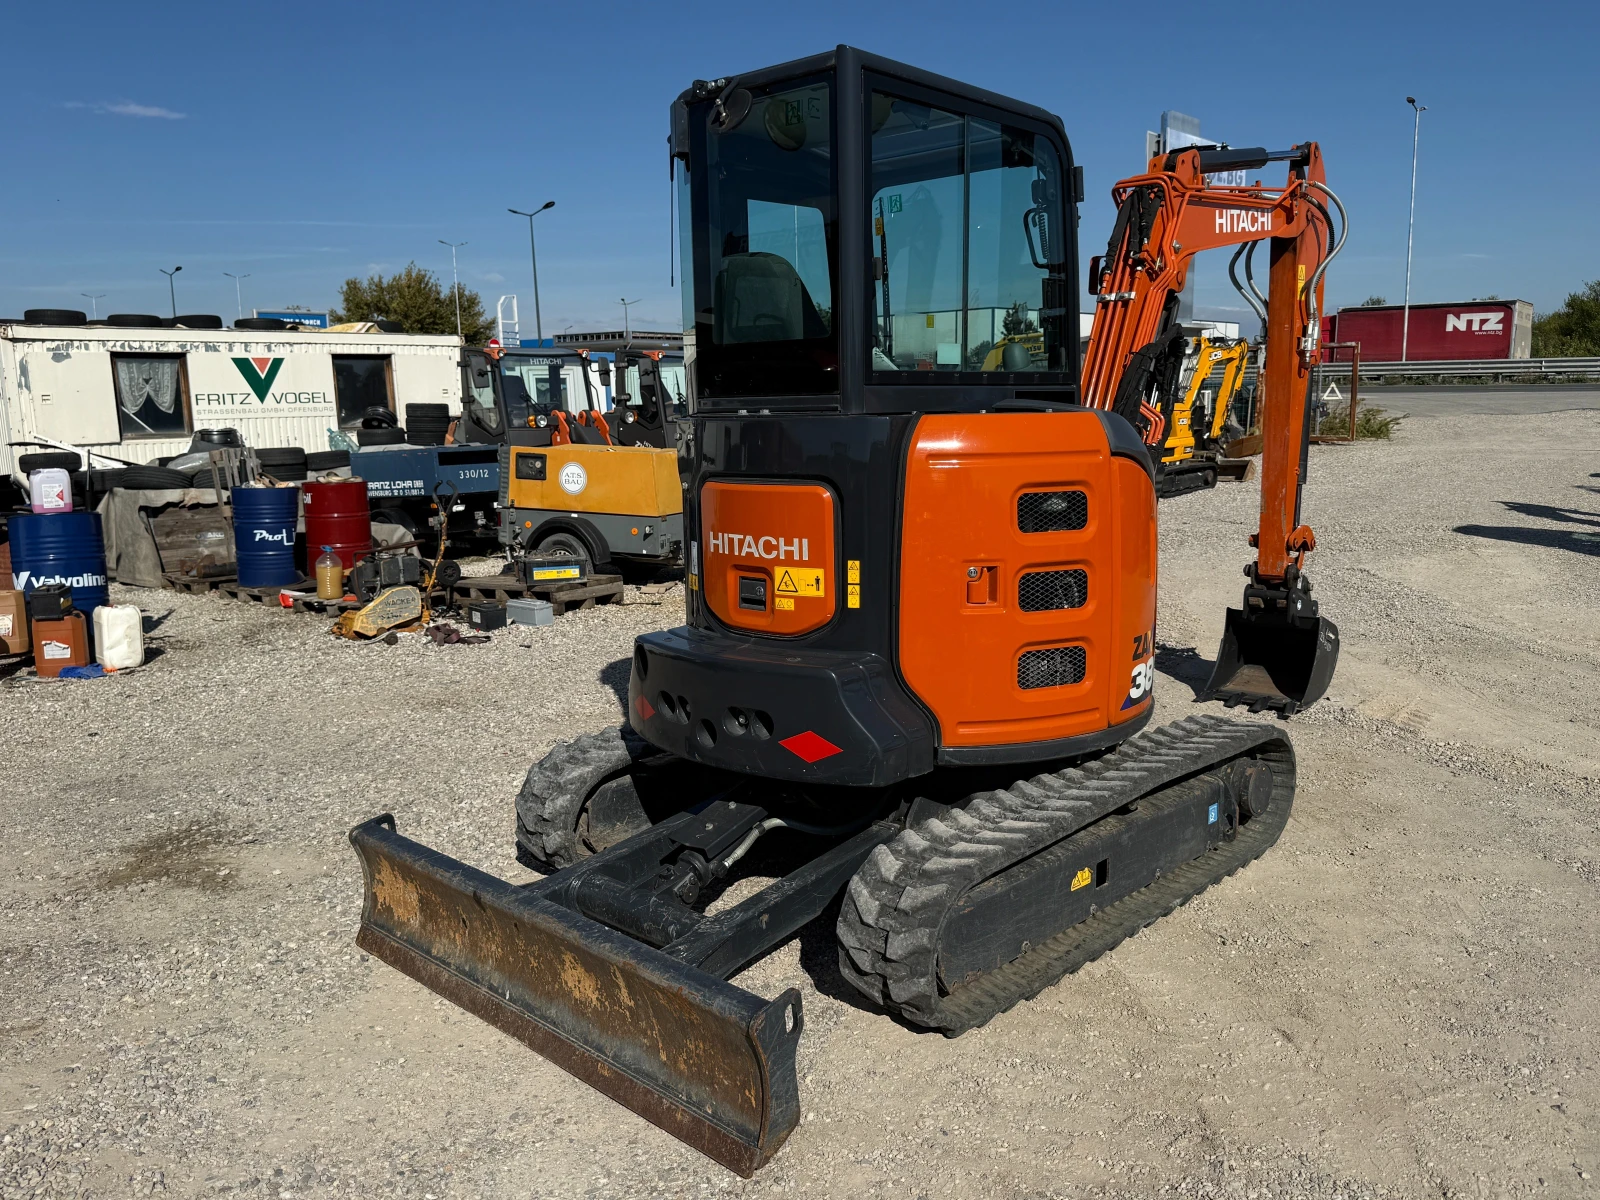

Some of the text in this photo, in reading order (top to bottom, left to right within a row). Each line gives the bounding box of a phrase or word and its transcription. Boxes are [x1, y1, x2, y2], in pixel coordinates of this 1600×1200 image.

[1215, 208, 1272, 234] HITACHI
[1445, 312, 1504, 332] NTZ
[1209, 350, 1222, 361] JCB
[195, 392, 333, 406] FRITZ VOGEL
[196, 408, 258, 416] STRASSENBAU
[287, 406, 334, 414] OFFENBURG
[459, 469, 489, 480] 330/12
[391, 481, 413, 489] LOHR
[564, 478, 582, 486] BAU
[709, 532, 809, 560] HITACHI
[31, 573, 107, 589] Valvoline
